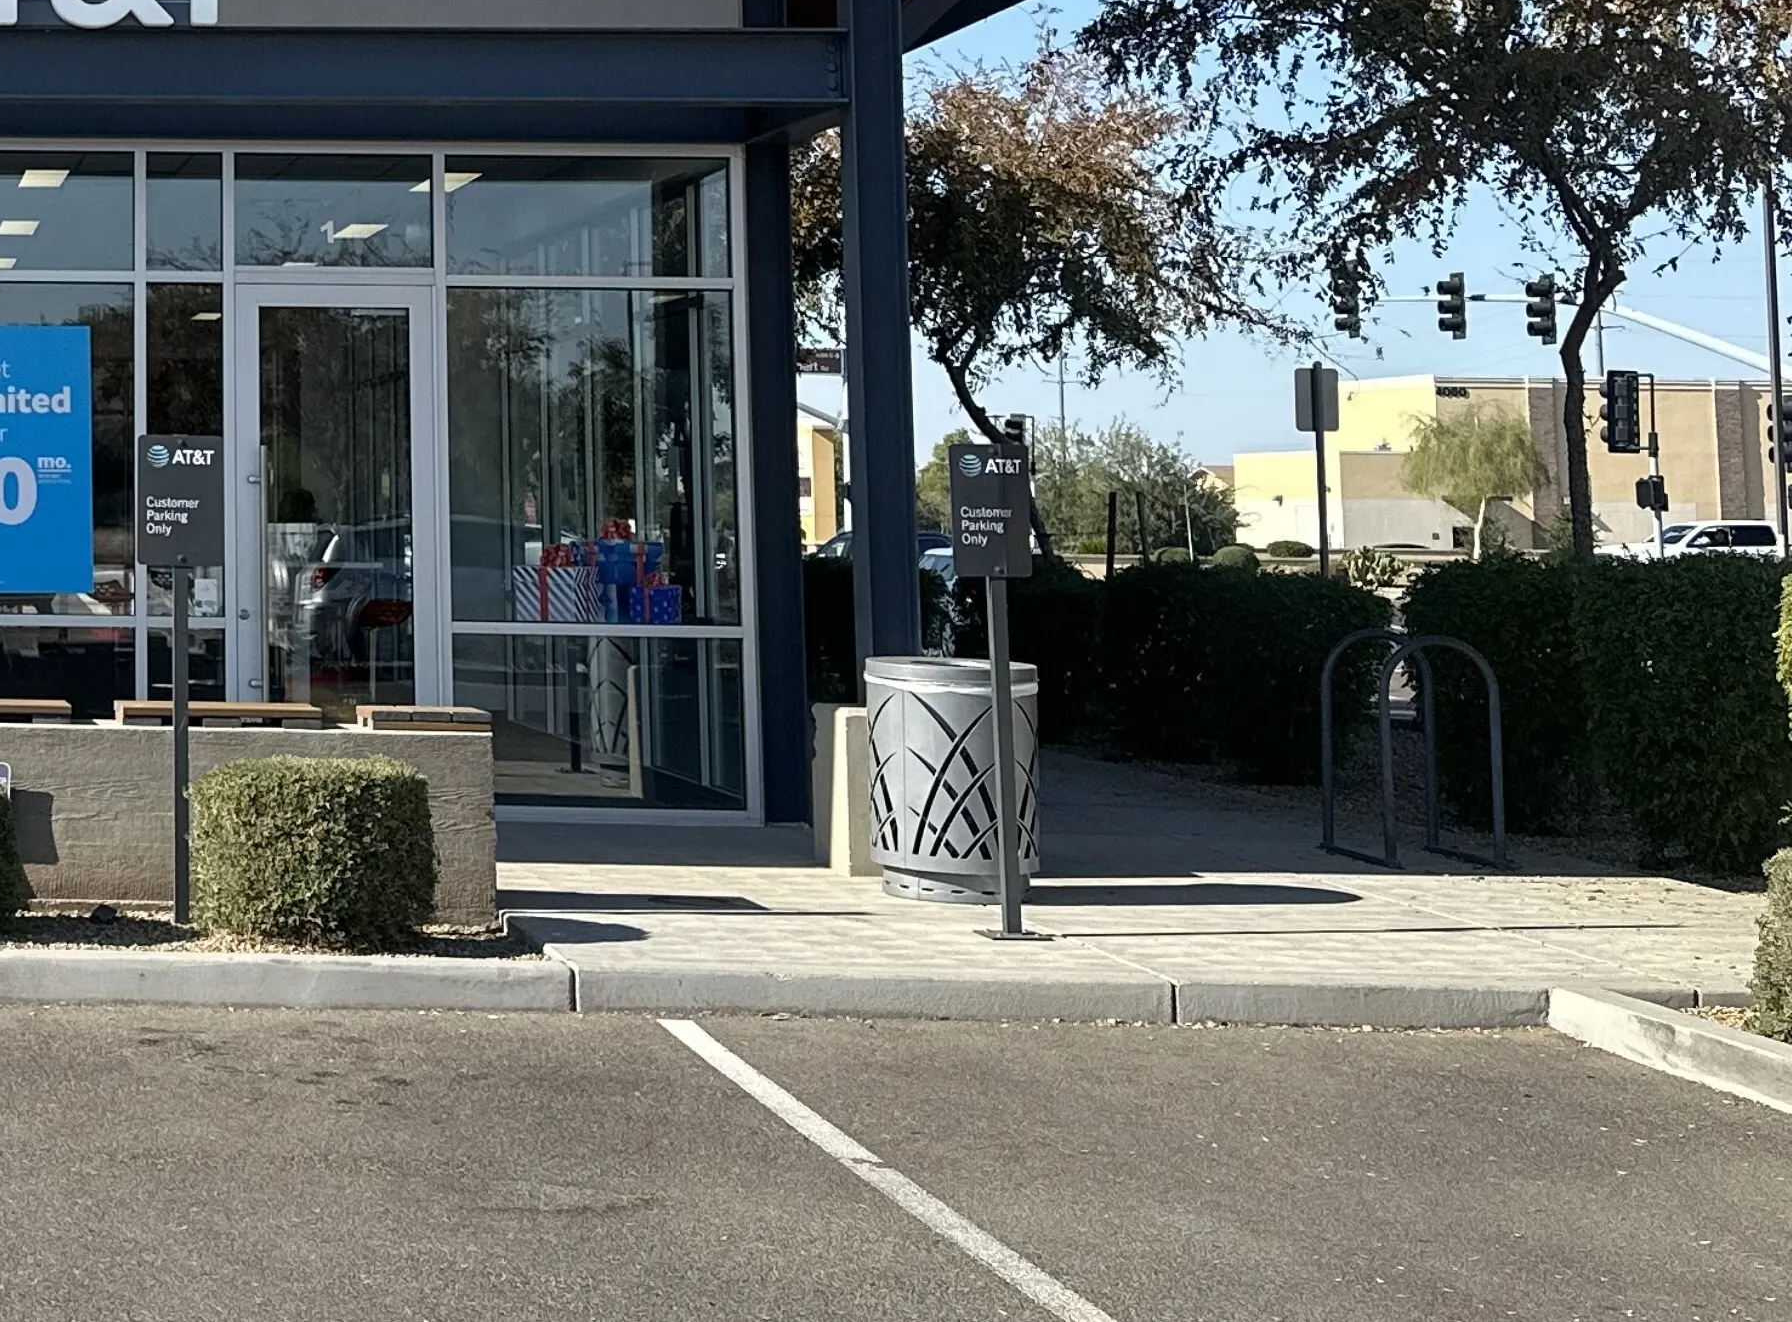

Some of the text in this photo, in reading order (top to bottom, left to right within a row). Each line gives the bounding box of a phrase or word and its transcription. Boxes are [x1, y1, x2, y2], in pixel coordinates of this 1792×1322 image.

[320, 220, 335, 244] 1
[37, 457, 72, 469] mo.
[172, 449, 215, 466] AT&T
[985, 458, 1022, 475] AT&T
[146, 496, 200, 509] Customer
[146, 509, 189, 525] Parking
[960, 505, 1013, 518] Customer
[145, 522, 173, 537] Only
[961, 519, 1005, 534] Parking
[961, 532, 989, 548] Only
